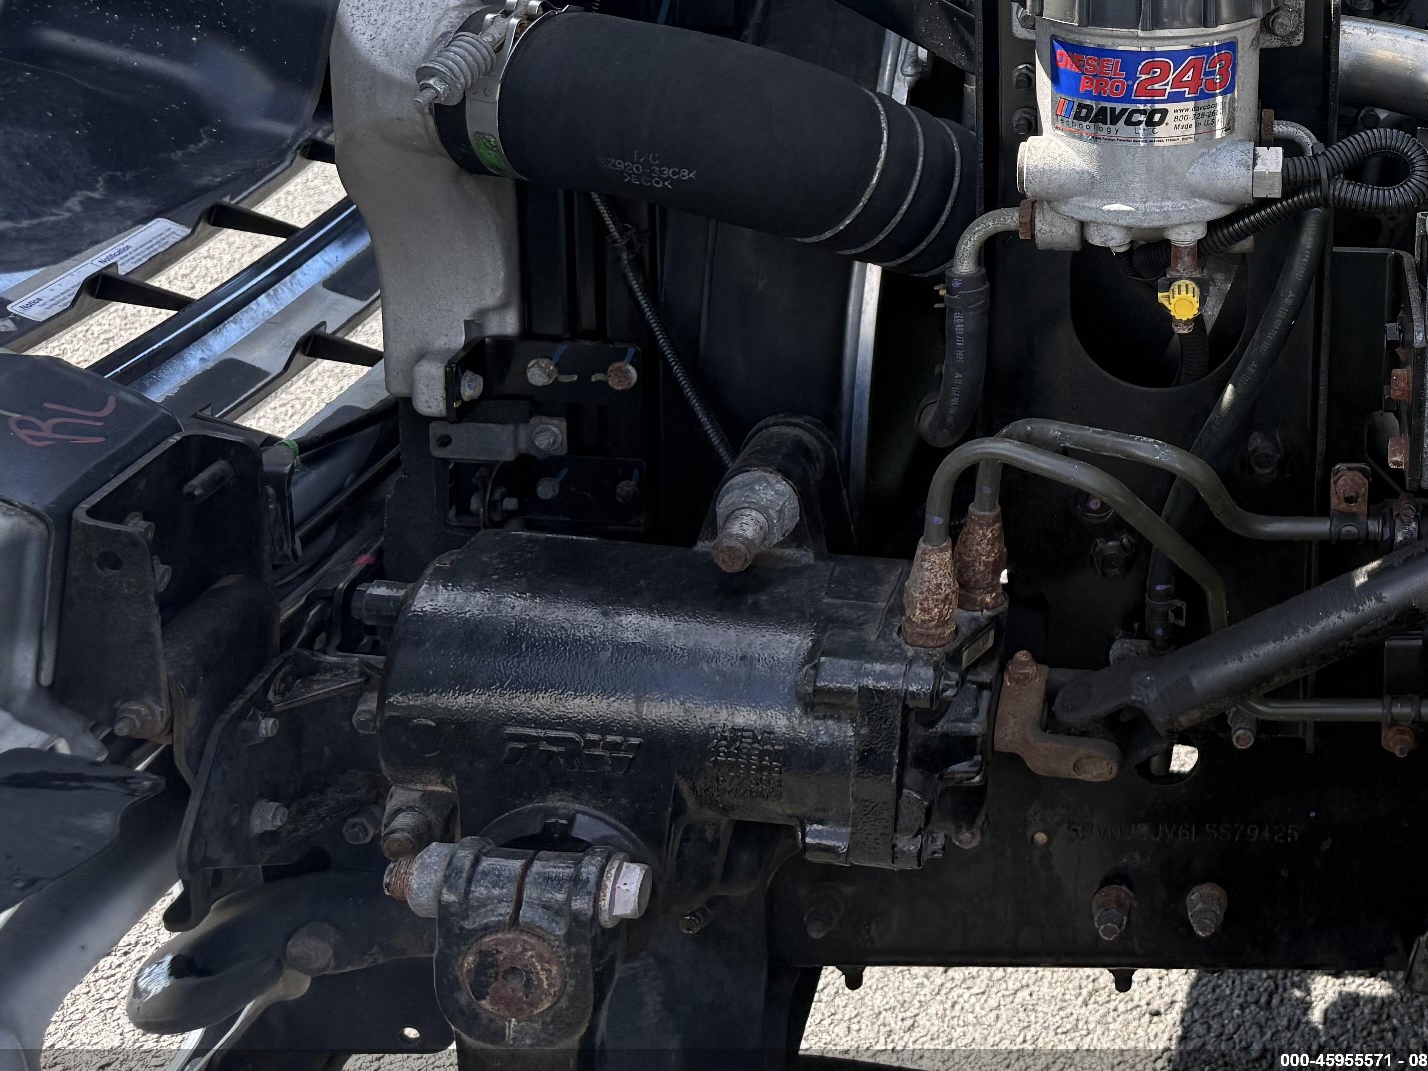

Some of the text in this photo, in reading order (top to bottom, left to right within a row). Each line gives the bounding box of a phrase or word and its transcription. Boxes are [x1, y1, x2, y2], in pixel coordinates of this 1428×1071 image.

[1055, 49, 1235, 100] DIESEL 243
[1079, 76, 1127, 98] PRO
[1073, 102, 1169, 128] DAVCO
[98, 244, 133, 265] Notification
[20, 296, 44, 311] Notice
[502, 725, 645, 774] TRW
